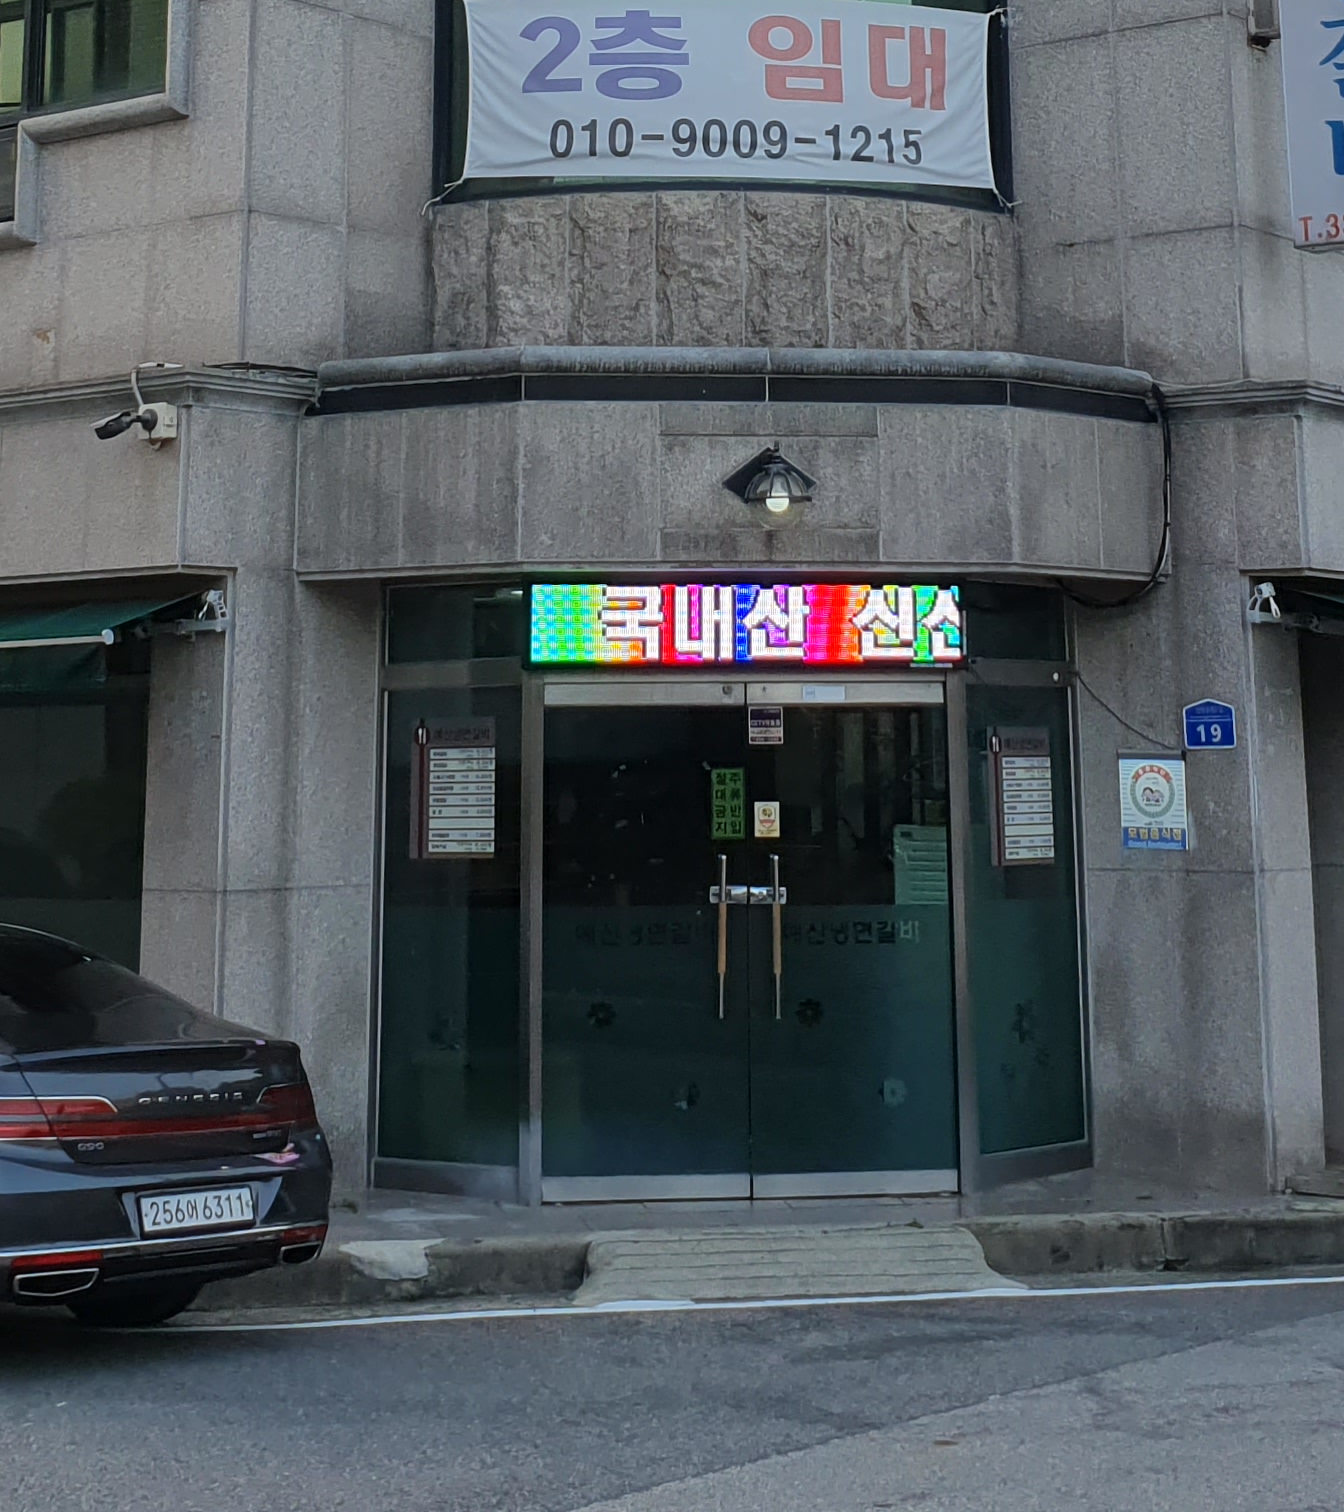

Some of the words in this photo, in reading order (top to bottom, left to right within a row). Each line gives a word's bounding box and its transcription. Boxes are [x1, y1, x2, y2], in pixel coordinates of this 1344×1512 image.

[518, 10, 690, 101] 2층
[747, 15, 946, 110] 임대
[549, 118, 923, 166] 010-9009-1215
[602, 585, 808, 659] 국내산
[1196, 723, 1223, 743] 19
[77, 1142, 105, 1152] G90
